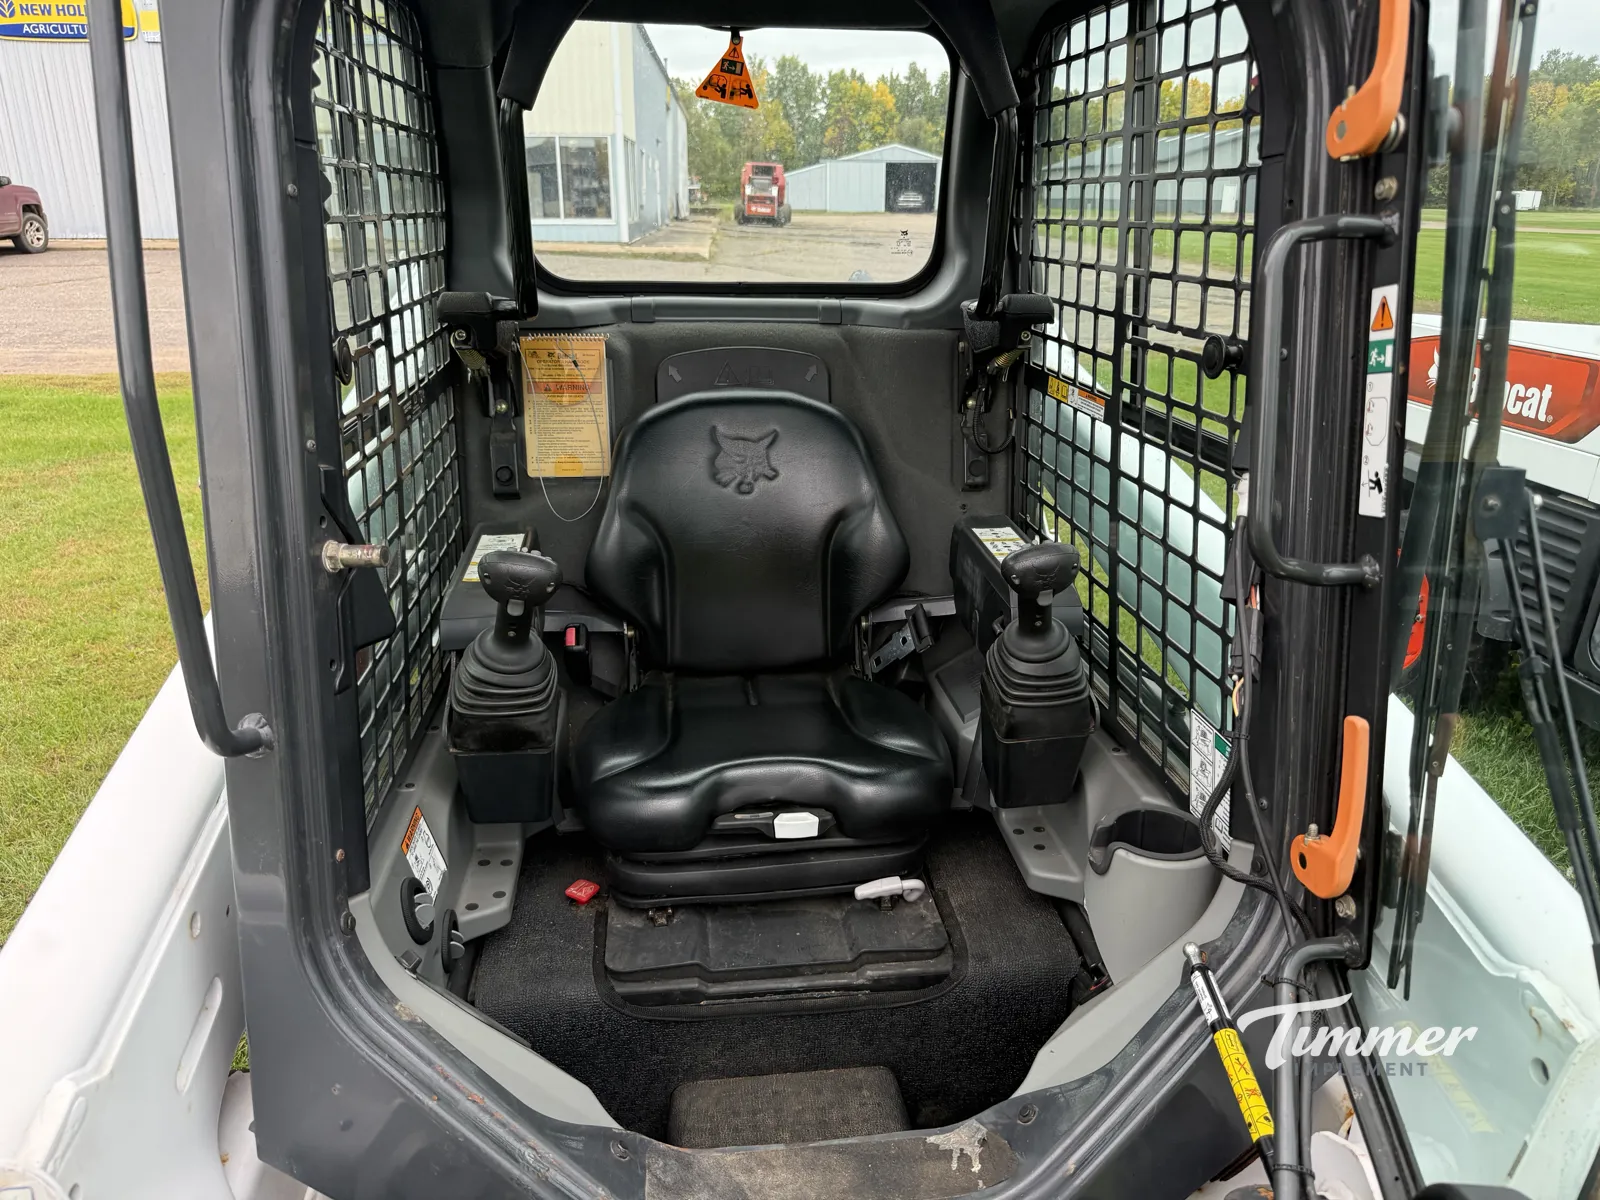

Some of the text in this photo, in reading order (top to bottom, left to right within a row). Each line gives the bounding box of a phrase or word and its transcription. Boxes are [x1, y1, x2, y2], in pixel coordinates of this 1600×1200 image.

[19, 3, 87, 17] NEW HOL
[22, 23, 88, 35] AGRICULTU
[555, 384, 590, 392] WARNING
[1469, 366, 1554, 423] Bcat
